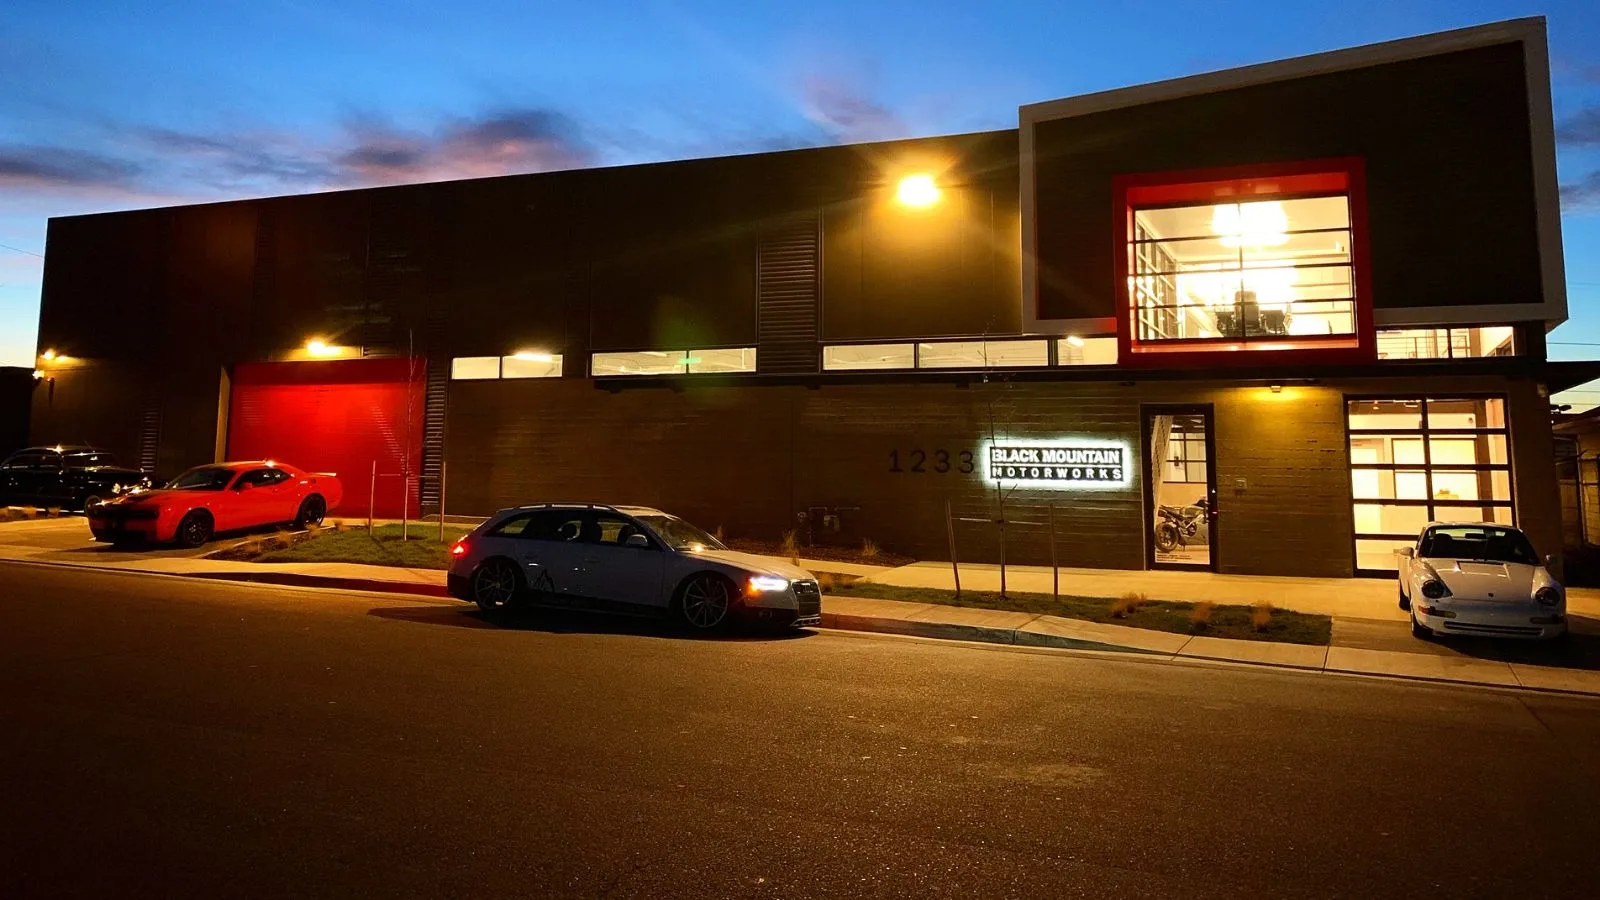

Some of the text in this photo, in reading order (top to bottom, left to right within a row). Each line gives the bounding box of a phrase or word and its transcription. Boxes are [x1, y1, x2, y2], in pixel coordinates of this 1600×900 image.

[888, 449, 974, 474] 1233
[991, 449, 1120, 464] BLACK MOUNTAIN
[991, 466, 1122, 480] MOTORWORKS
